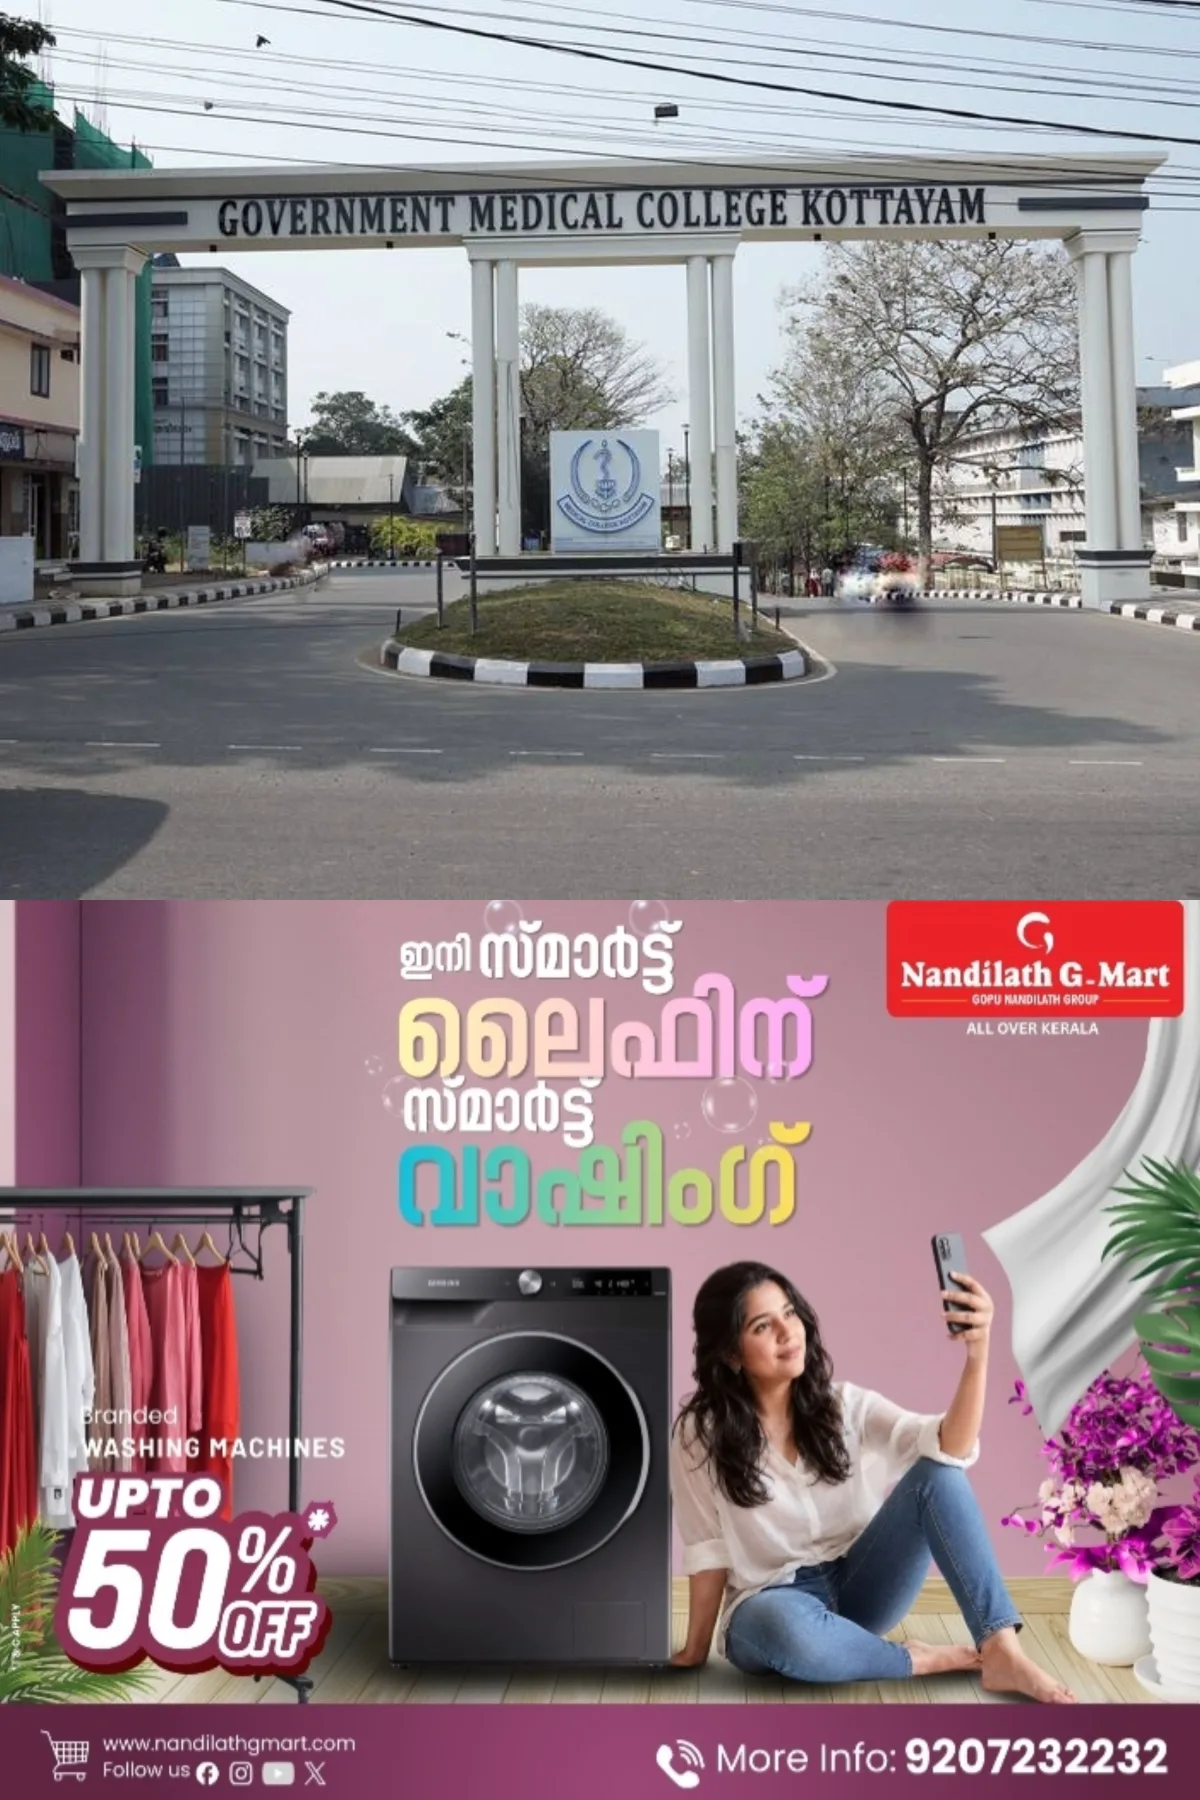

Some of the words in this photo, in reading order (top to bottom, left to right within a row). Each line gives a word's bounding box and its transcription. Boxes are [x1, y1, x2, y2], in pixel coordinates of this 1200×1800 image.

[217, 197, 456, 237] GOVERNMENT
[469, 192, 624, 233] MEDICAL
[635, 189, 788, 230] COLLEGE
[801, 187, 986, 226] KOTTAYAM
[400, 932, 471, 980] ഇനി
[479, 920, 683, 995] സ്മാർട്ട്
[901, 960, 1053, 988] Nandilath
[1059, 961, 1170, 988] G-Mart
[972, 994, 1002, 1006] GOPU
[1004, 994, 1061, 1006] NANDILATH
[1063, 994, 1100, 1006] GROUP
[398, 972, 830, 1078] ലൈഫിന്
[966, 1021, 994, 1035] ALL
[997, 1021, 1038, 1035] OVER
[1042, 1021, 1100, 1035] KERALA
[403, 1074, 602, 1148] സ്മാർട്ട്
[398, 1119, 812, 1226] വാഷിംഗ്
[80, 1405, 179, 1426] Branded
[82, 1436, 201, 1459] WASHING
[210, 1436, 346, 1459] MACHINES
[77, 1477, 222, 1519] UPTO
[11, 1603, 21, 1637] APPLY
[218, 1600, 318, 1658] OFF
[103, 1734, 356, 1757] www.nandilathgmart.com
[716, 1743, 808, 1774] More
[820, 1741, 896, 1774] Info:
[905, 1737, 1169, 1775] 9207232232
[103, 1761, 164, 1779] Follow
[168, 1765, 191, 1779] us
